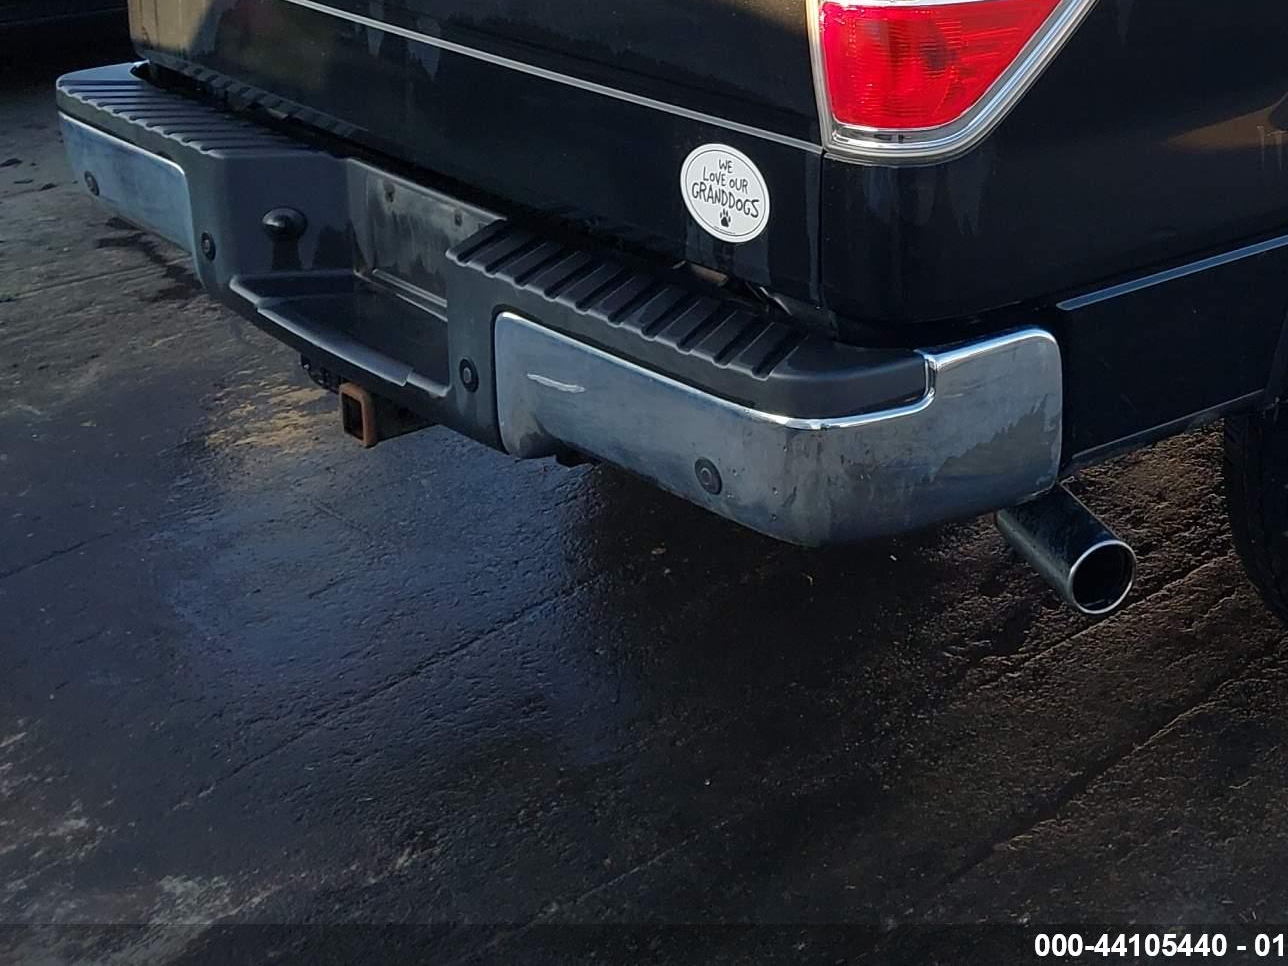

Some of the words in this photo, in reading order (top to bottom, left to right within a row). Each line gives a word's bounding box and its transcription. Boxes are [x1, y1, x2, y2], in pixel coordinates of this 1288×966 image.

[703, 166, 727, 187] LOVE
[729, 177, 749, 195] OUR
[719, 160, 733, 174] WE
[692, 181, 760, 218] GRANDDOGS
